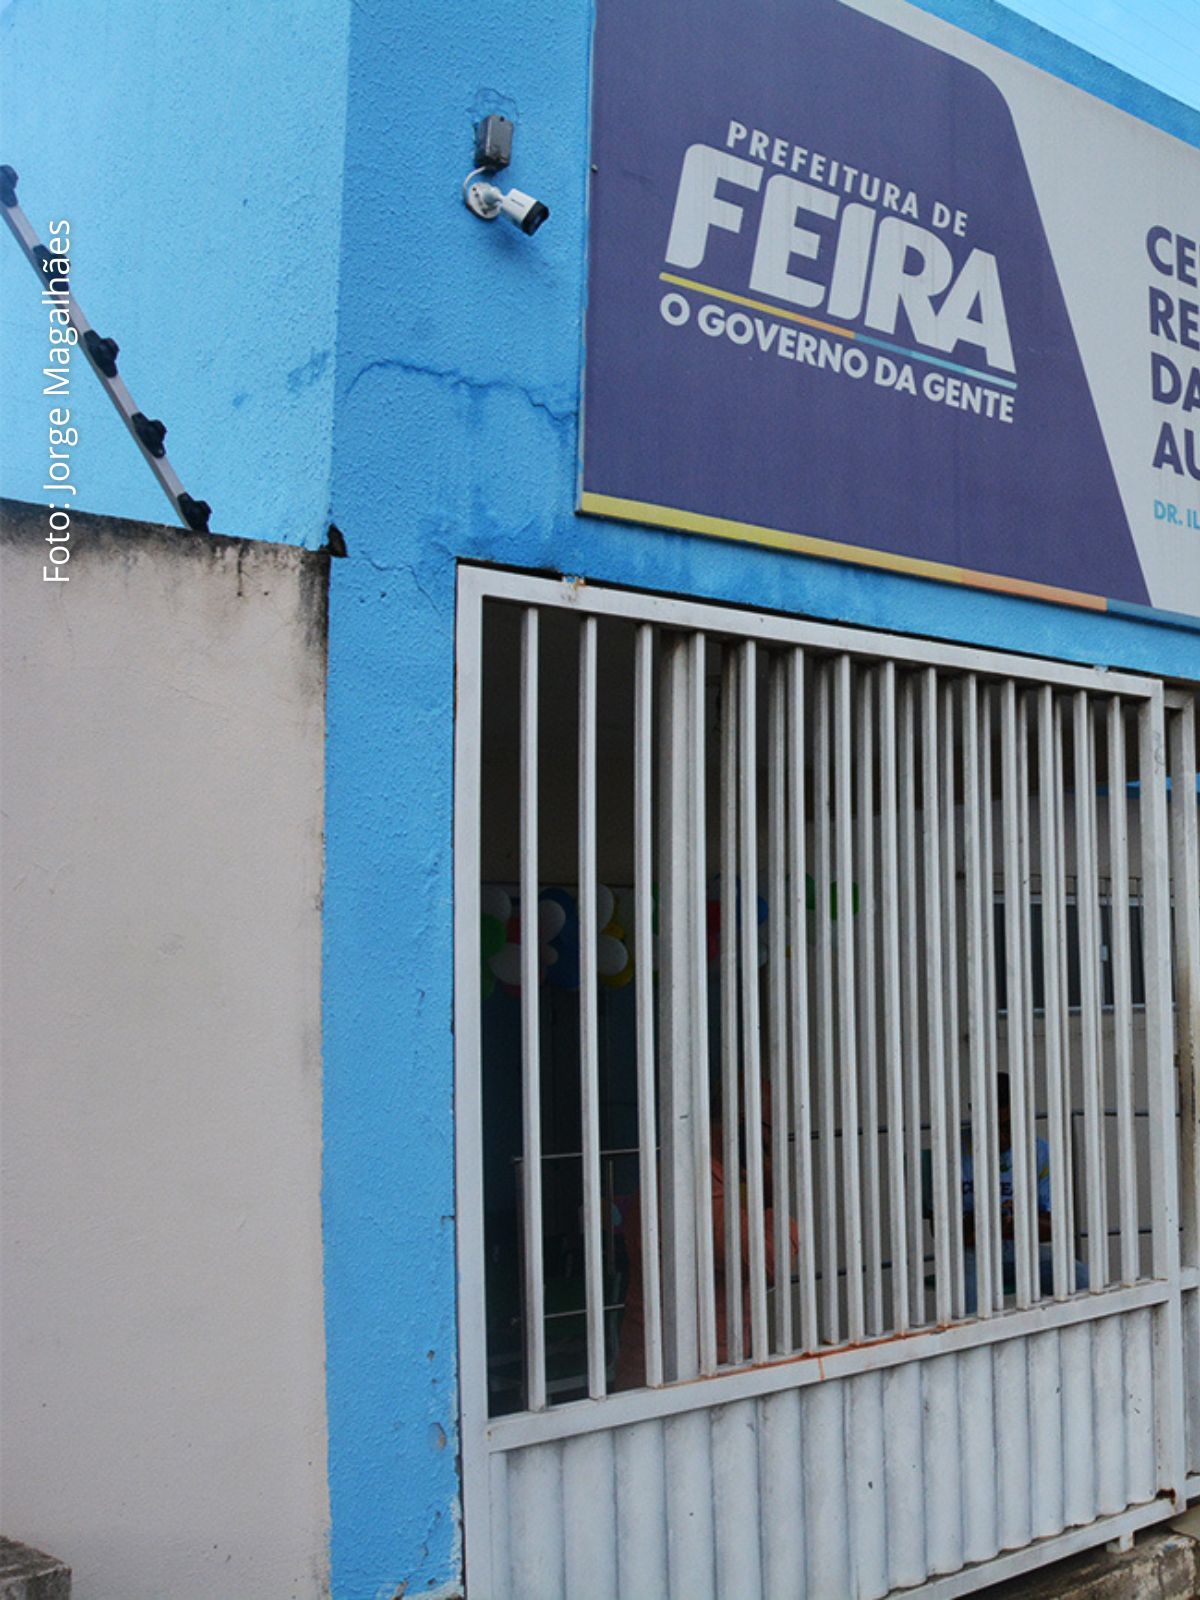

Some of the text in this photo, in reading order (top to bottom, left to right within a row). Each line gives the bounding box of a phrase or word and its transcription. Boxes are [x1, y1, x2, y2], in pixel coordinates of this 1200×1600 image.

[726, 120, 968, 237] PREFEITURA DE
[665, 143, 1016, 374] FEIRA
[660, 293, 1015, 423] O GOVERNO DA GENTE
[1154, 500, 1183, 526] DR.
